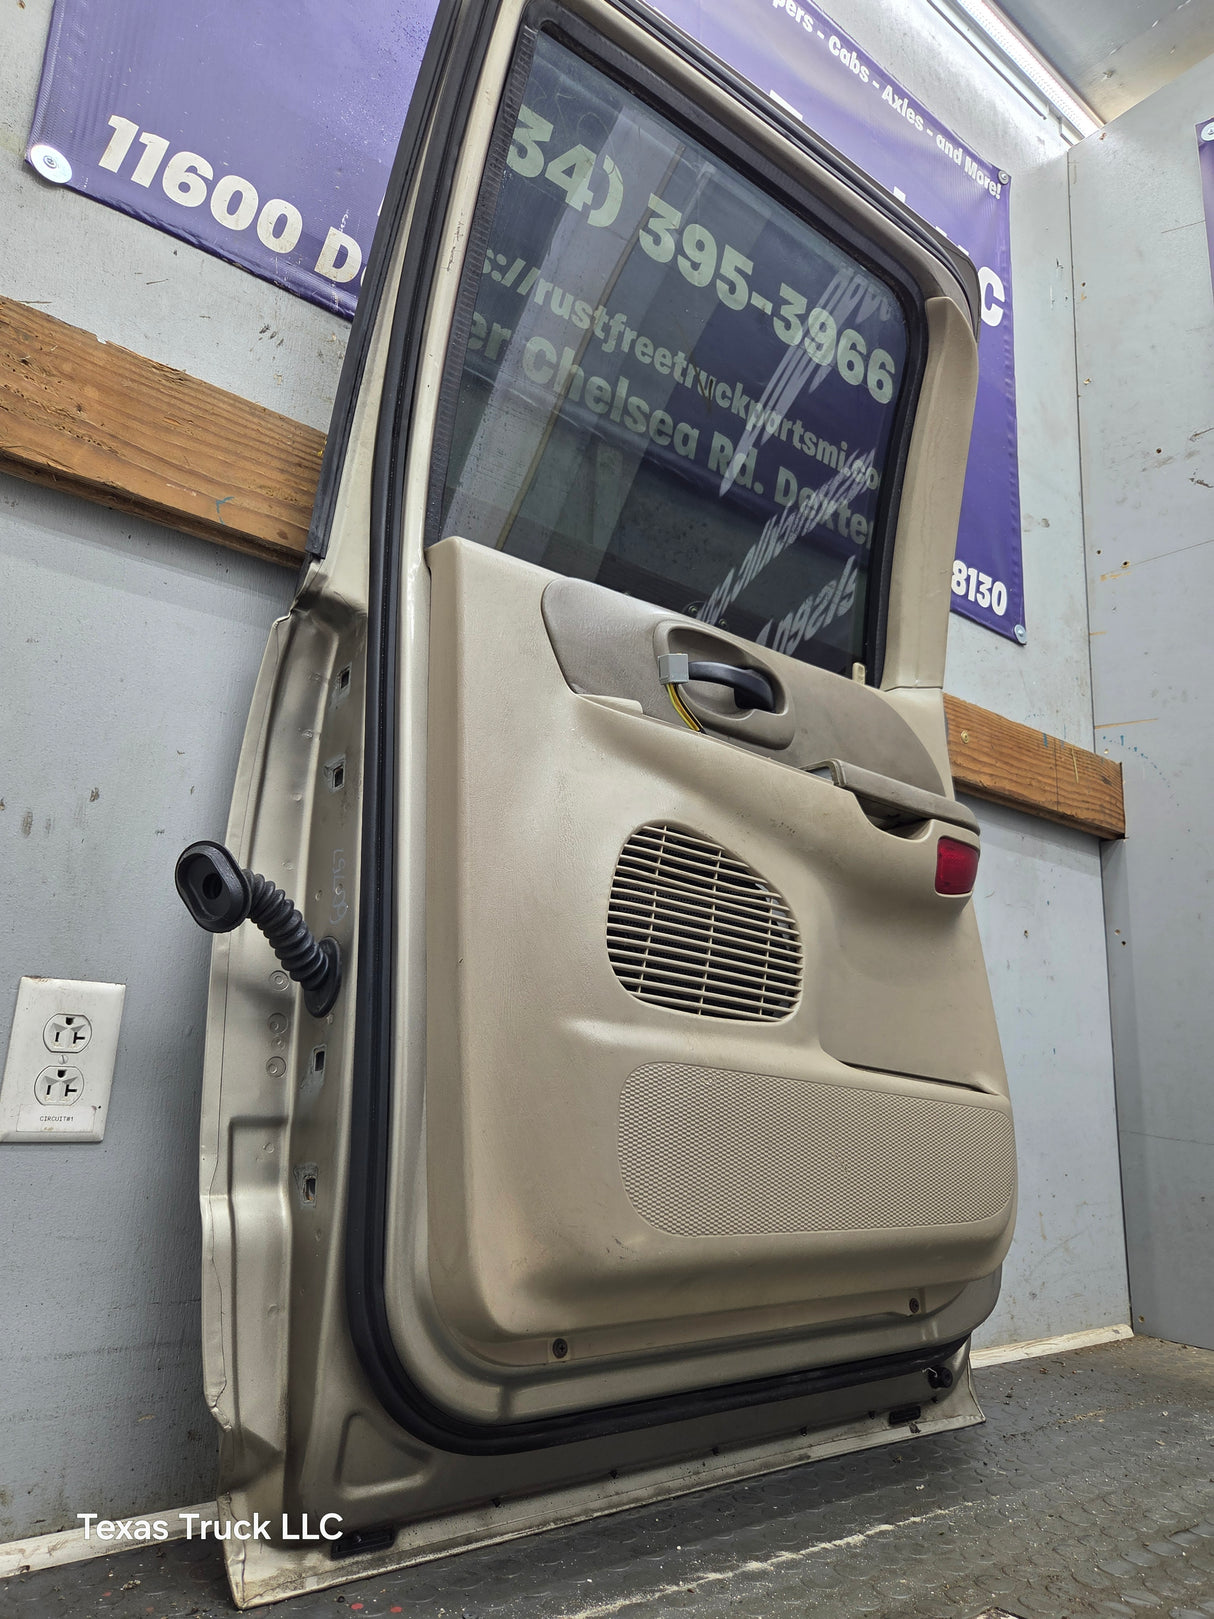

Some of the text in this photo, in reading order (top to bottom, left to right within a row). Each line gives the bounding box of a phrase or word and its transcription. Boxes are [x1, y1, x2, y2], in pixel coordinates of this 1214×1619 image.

[828, 36, 870, 83] Cabs
[882, 85, 924, 132] Axles
[936, 135, 962, 166] and
[964, 156, 1002, 200] More!
[98, 114, 367, 287] 11600 D
[506, 104, 624, 228] 34)
[638, 193, 896, 404] 395-3966
[523, 336, 700, 460] Chelsea
[707, 430, 764, 495] Rd.
[951, 559, 1007, 616] 8130
